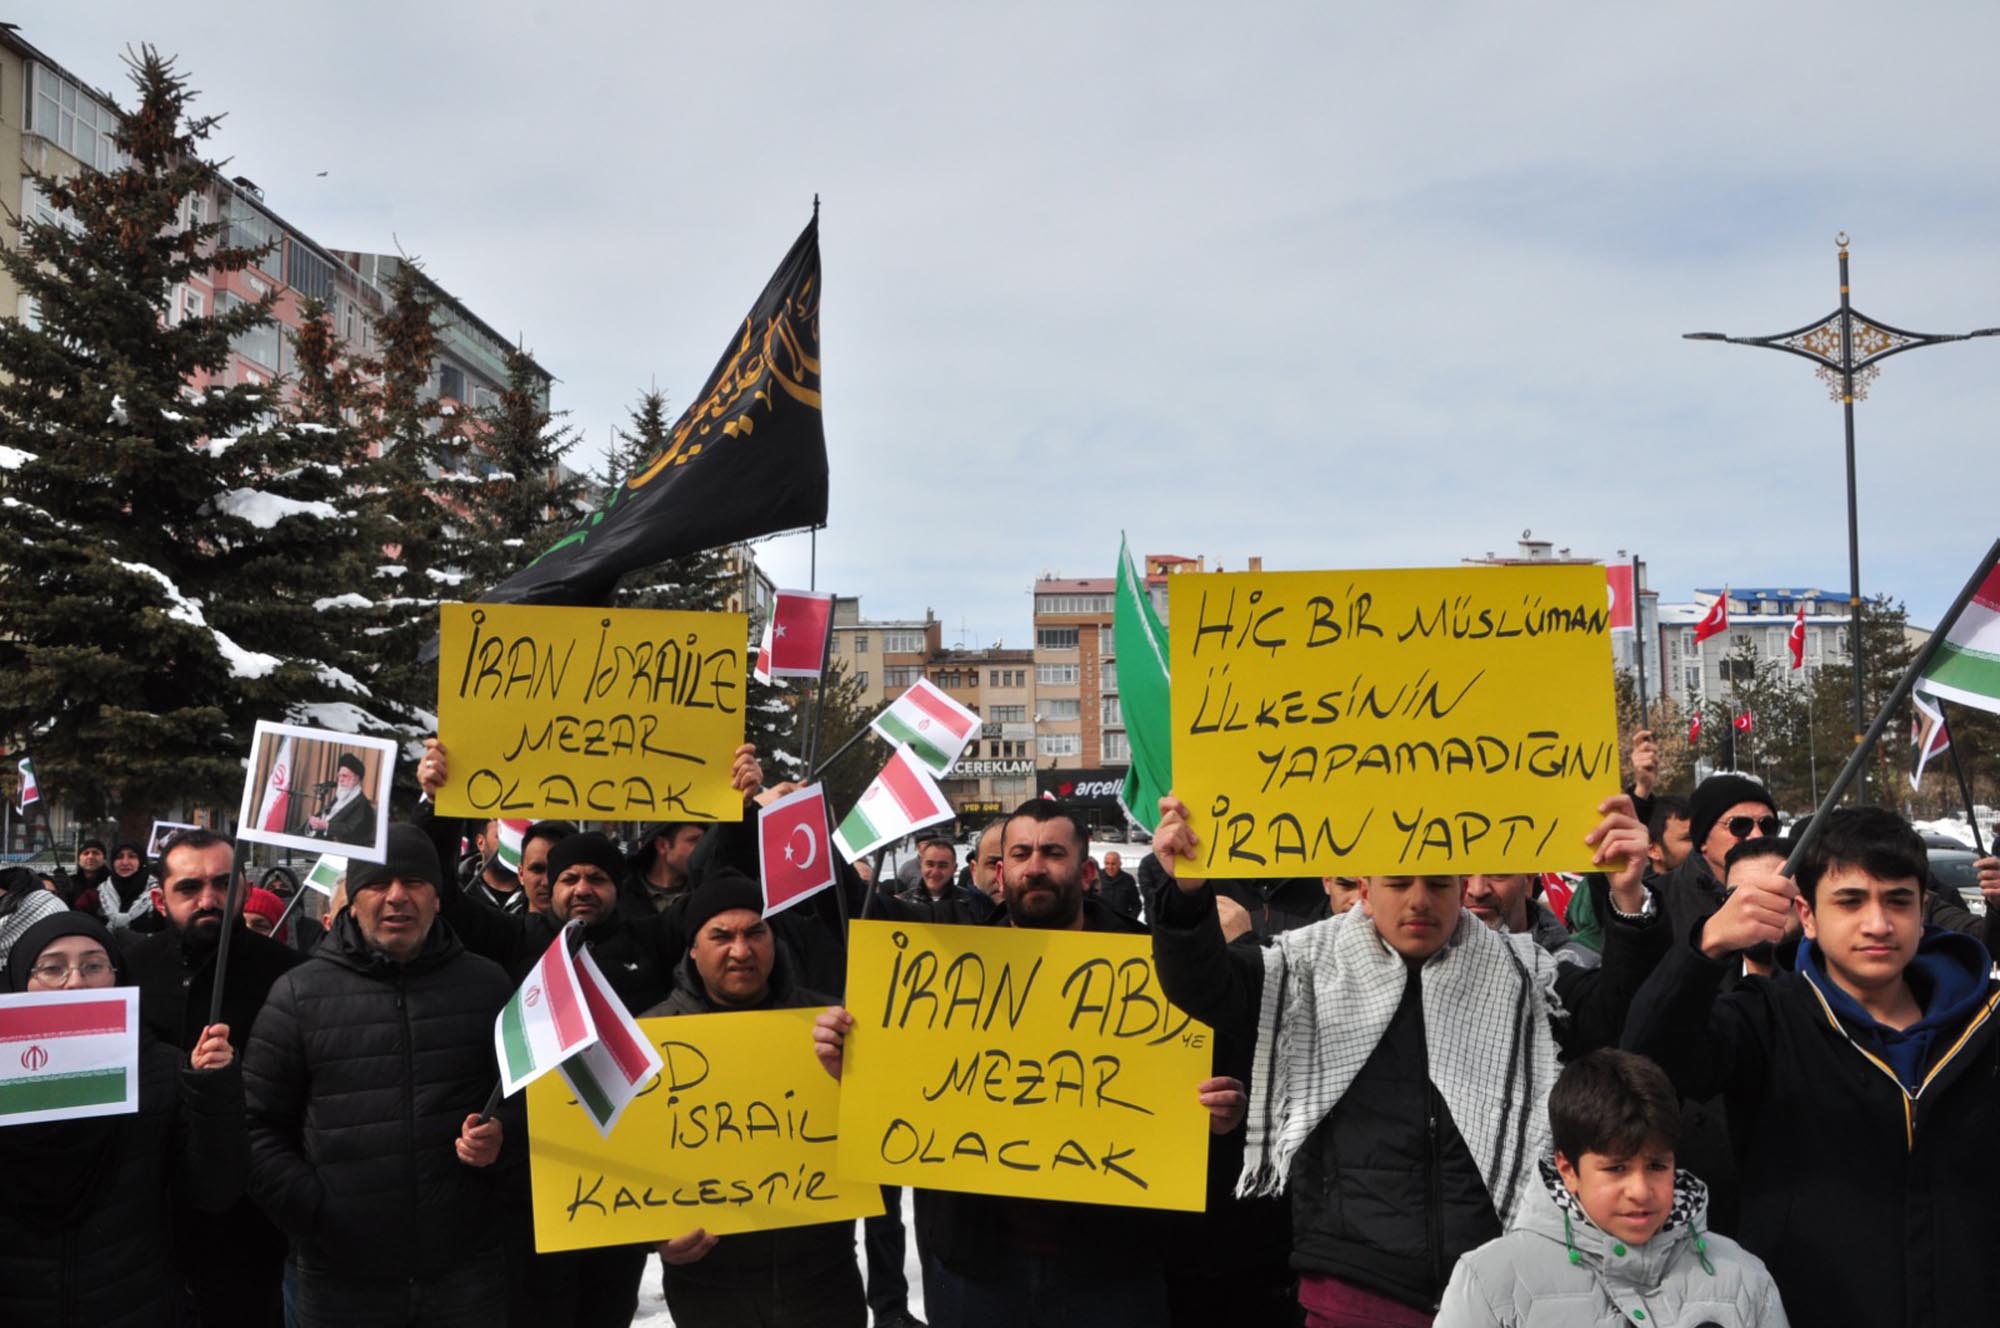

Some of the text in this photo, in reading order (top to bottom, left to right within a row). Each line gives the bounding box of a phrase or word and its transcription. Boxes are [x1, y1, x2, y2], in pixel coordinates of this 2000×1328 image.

[460, 609, 576, 699] İRAN
[1193, 586, 1287, 658] HİÇ
[1306, 583, 1384, 649] BİR
[1190, 664, 1486, 735] ÜLKESİNİN
[503, 714, 706, 765] MEZAR
[950, 761, 1034, 774] CEREKLAM
[1258, 731, 1613, 793] YAPAMADIĞINI
[467, 769, 719, 820] OLACAK
[1075, 778, 1123, 799] arçeli
[1207, 795, 1560, 868] İRAN YAPTI
[882, 931, 1043, 1031] İRAN
[922, 1049, 1155, 1116] MEZAR
[667, 1090, 838, 1149] İSRAİL
[881, 1118, 1149, 1191] OLACAK
